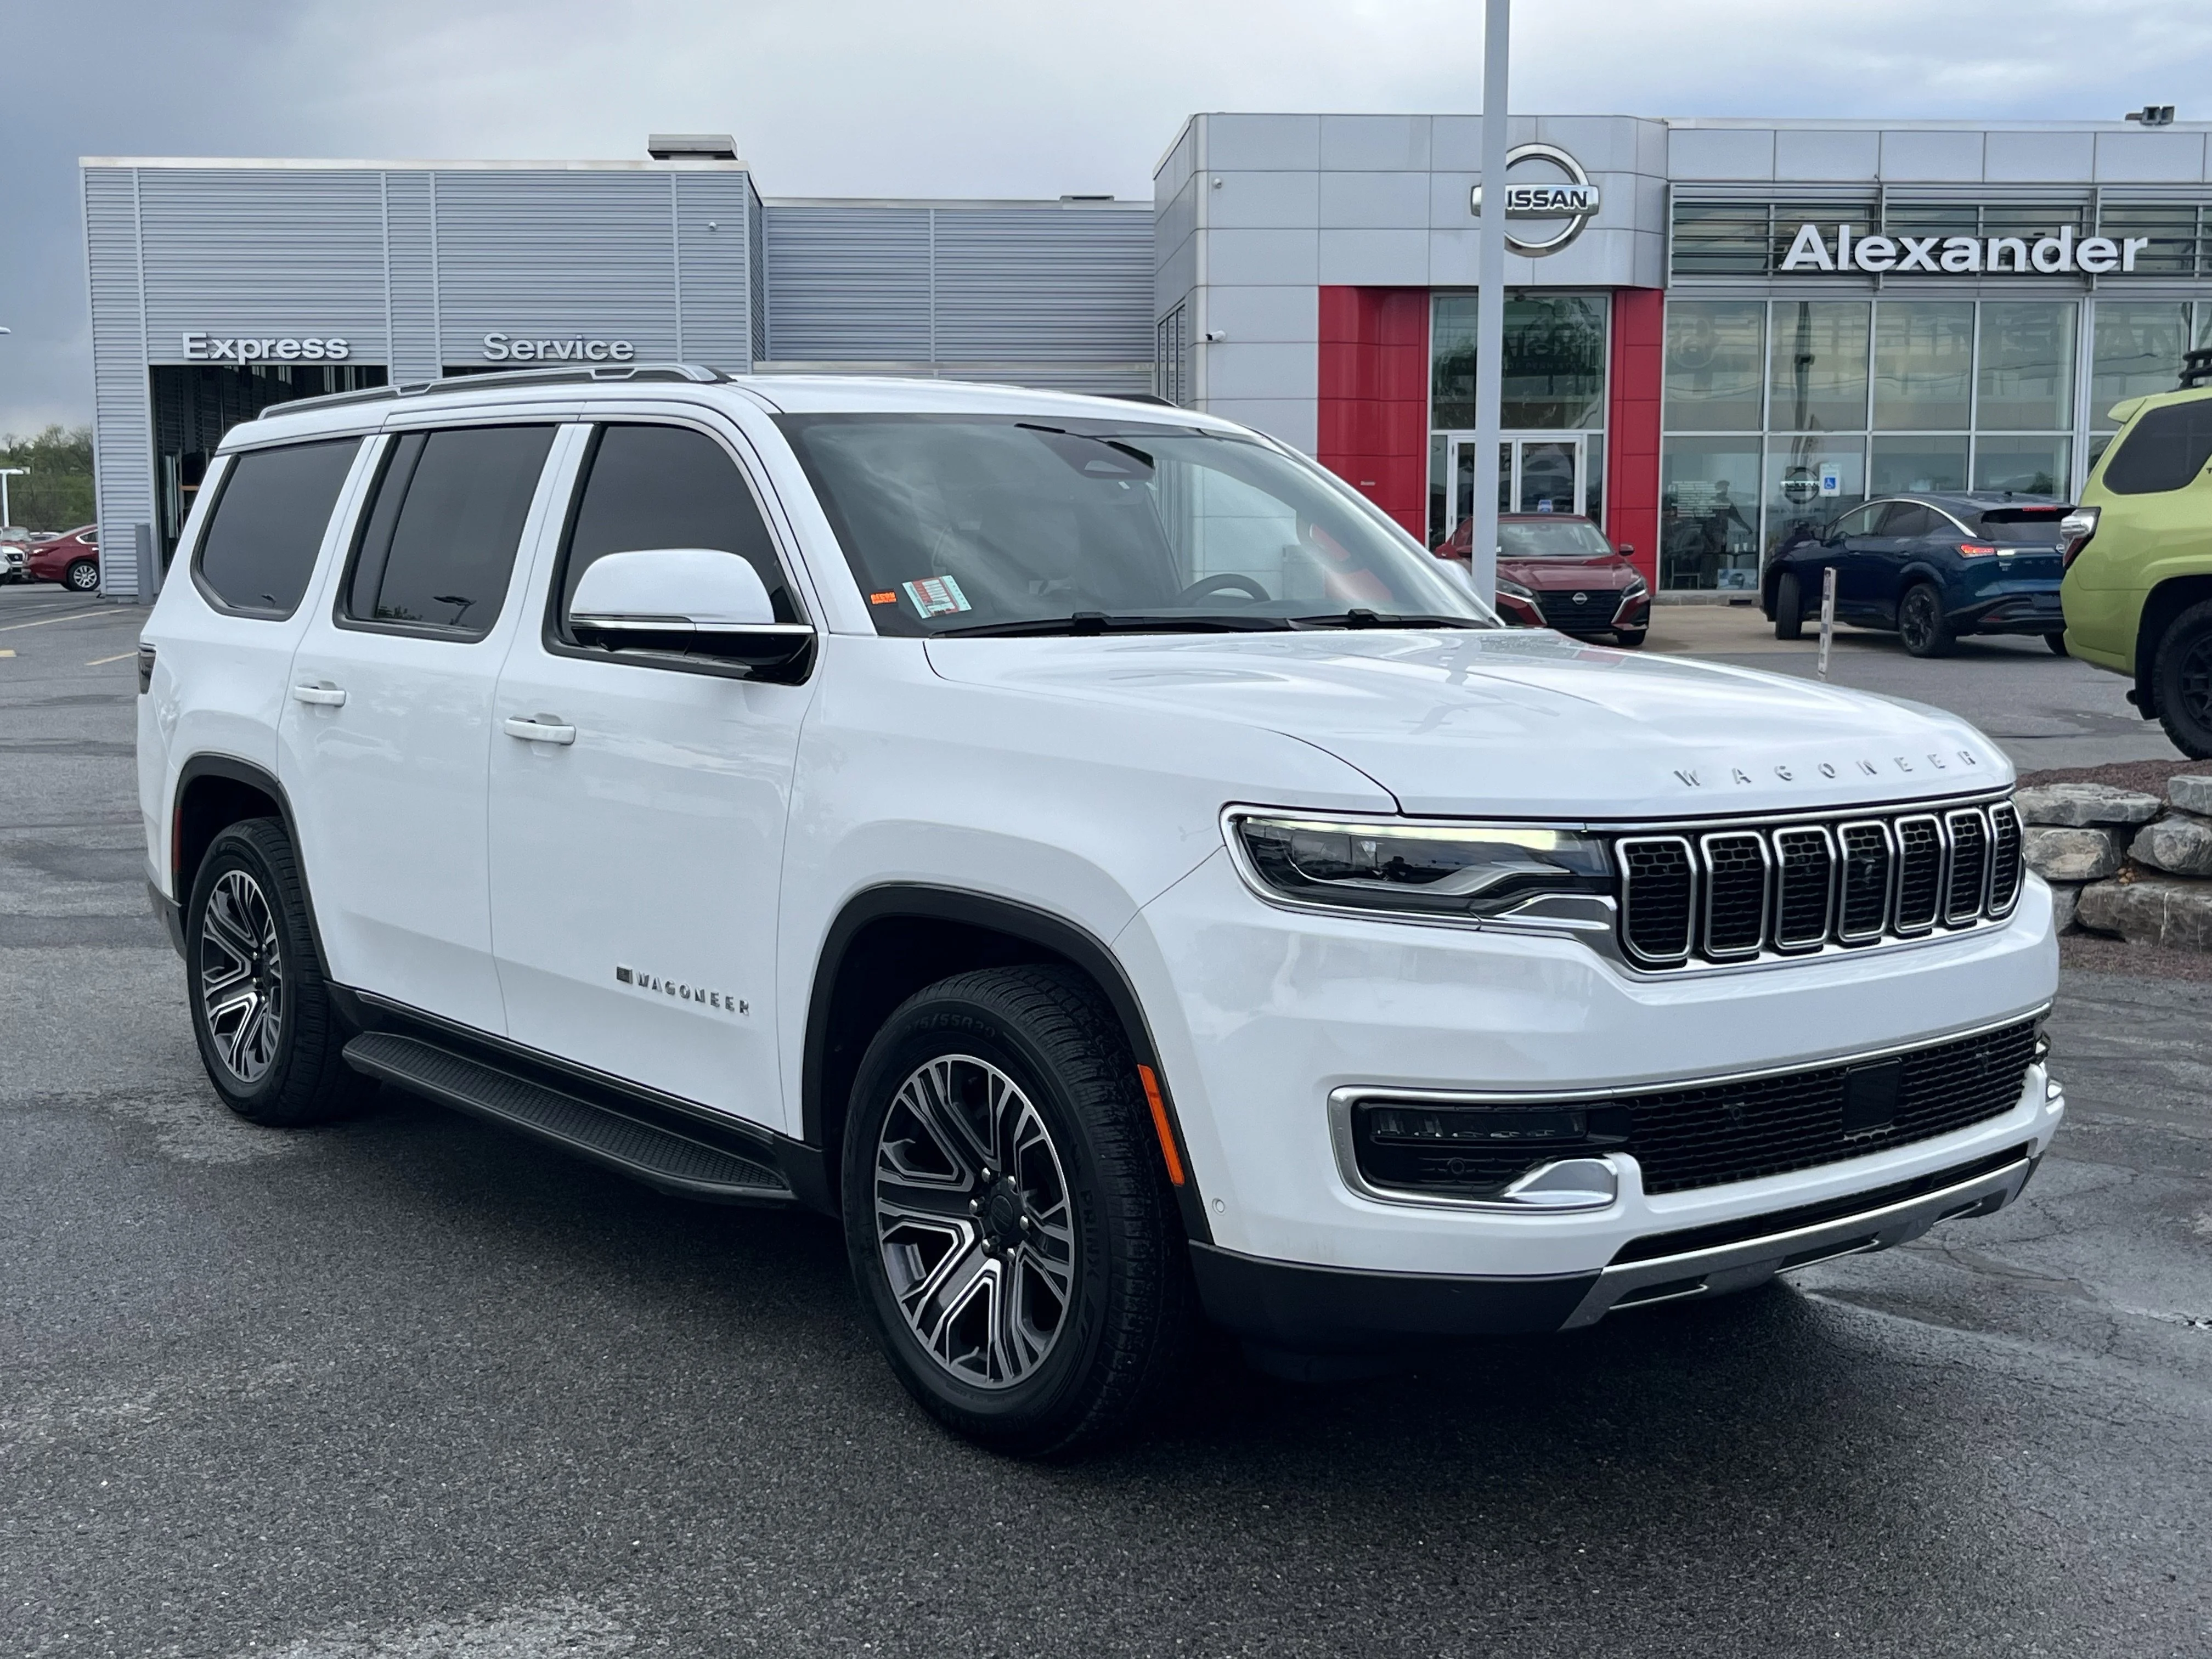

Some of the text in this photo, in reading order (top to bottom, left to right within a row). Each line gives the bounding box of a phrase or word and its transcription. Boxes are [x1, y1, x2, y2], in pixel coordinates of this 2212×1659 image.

[1507, 190, 1588, 208] ISSAN
[1780, 224, 2148, 273] Alexander
[182, 332, 349, 364] Express
[482, 332, 634, 361] Service
[1673, 751, 1976, 787] WAGONEER
[636, 971, 749, 1016] WAGONEER
[1080, 1189, 1102, 1282] PRINX
